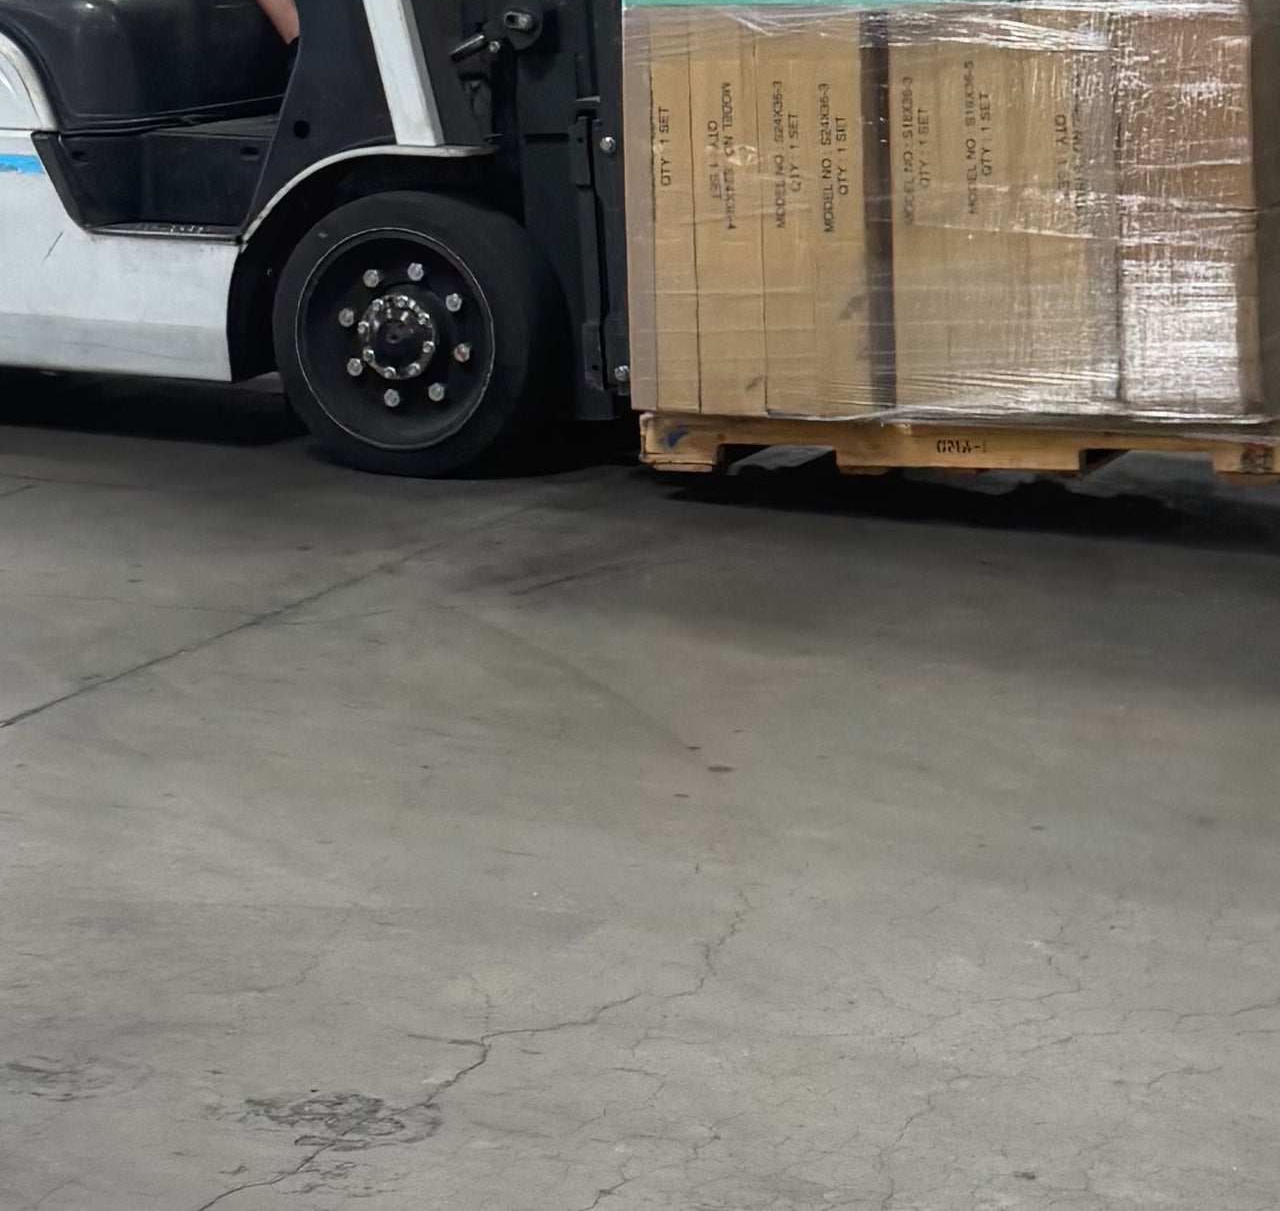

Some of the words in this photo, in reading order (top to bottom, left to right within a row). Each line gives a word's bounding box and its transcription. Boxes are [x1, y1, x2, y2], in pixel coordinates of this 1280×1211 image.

[658, 106, 669, 134] SET
[721, 82, 733, 132] MODEL
[979, 92, 991, 120] SET
[707, 120, 719, 149] QTY
[788, 112, 799, 140] SET
[917, 109, 930, 134] SET
[1054, 114, 1068, 146] QTY
[966, 138, 977, 160] NO
[980, 146, 992, 176] QTY
[660, 158, 671, 187] QTY
[821, 157, 832, 179] NO
[836, 166, 848, 196] QTY
[823, 184, 835, 233] MODEL
